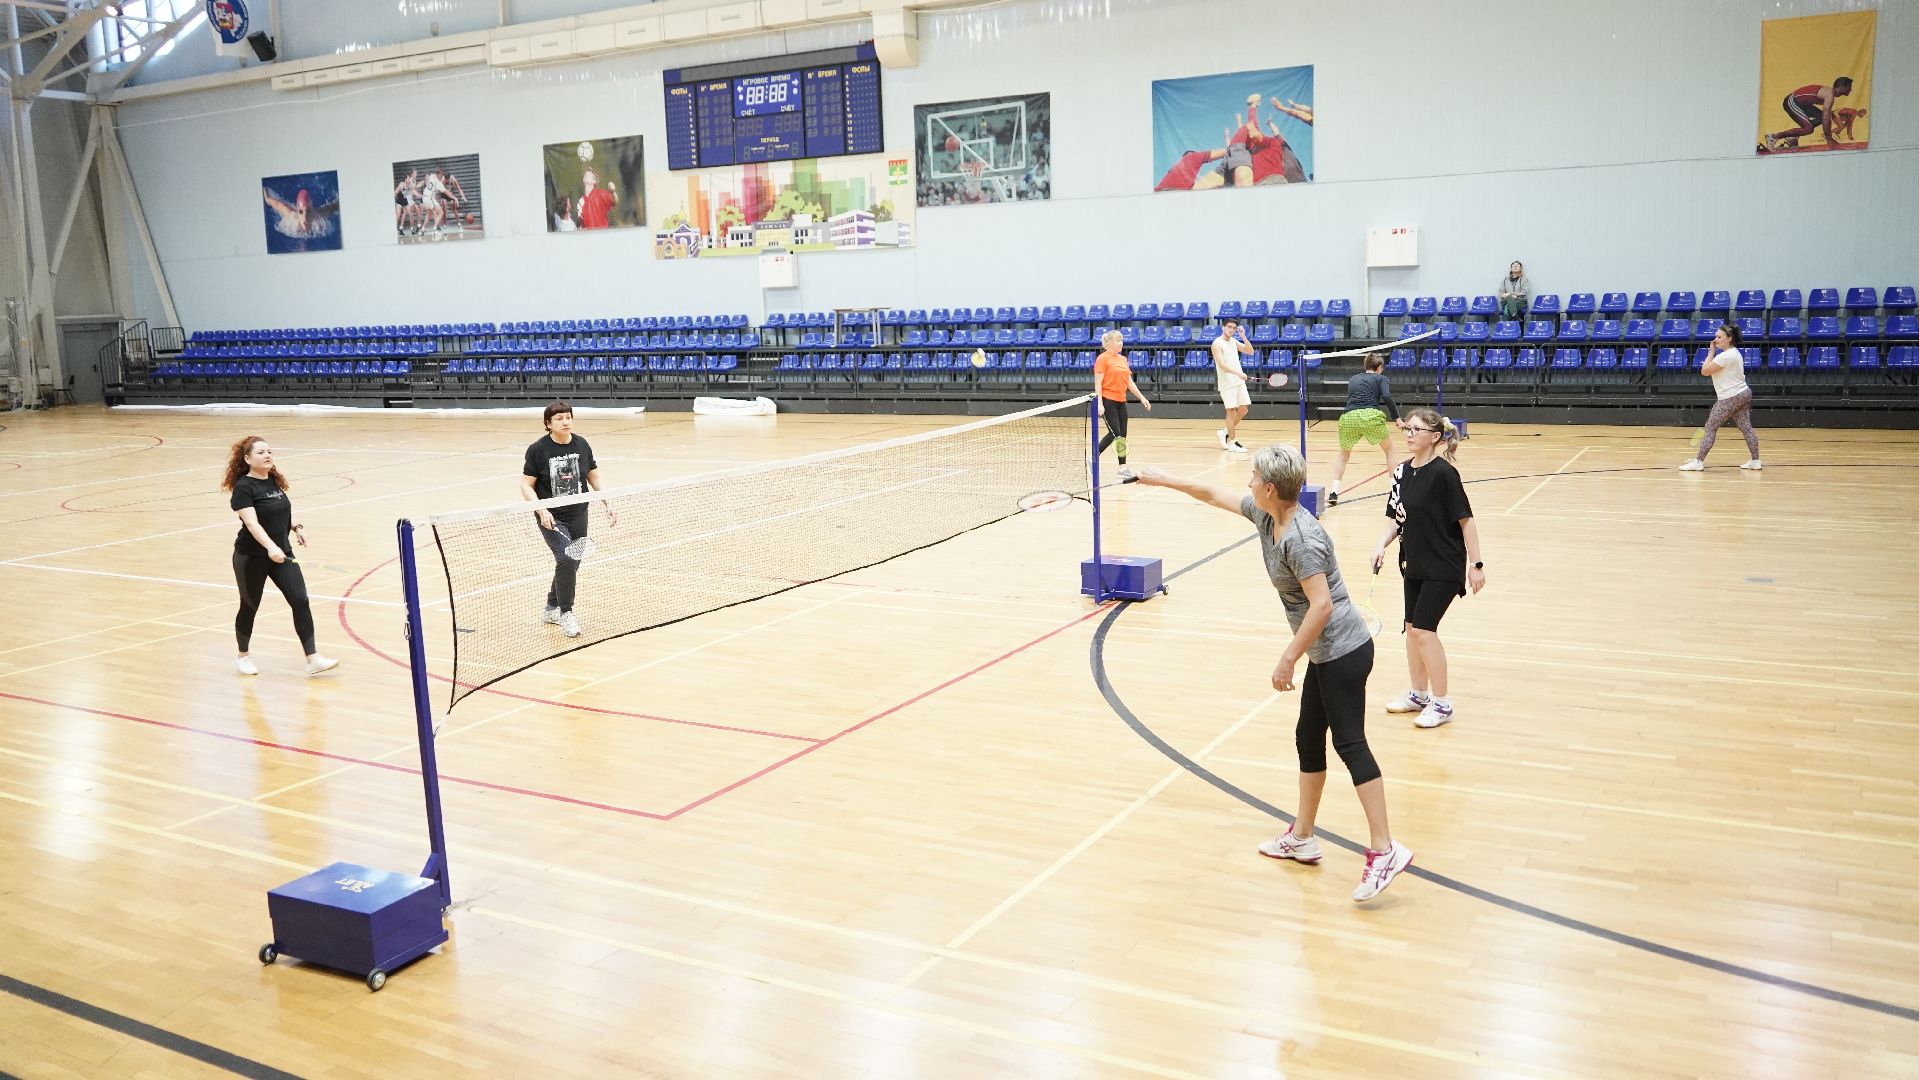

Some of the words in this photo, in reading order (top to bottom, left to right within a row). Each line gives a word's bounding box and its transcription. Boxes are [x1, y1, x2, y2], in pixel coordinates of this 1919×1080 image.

[817, 69, 837, 78] ВРЕМЯ
[742, 76, 768, 86] ИГРОВОЕ
[770, 74, 791, 83] ВРЕМЯ
[709, 82, 727, 91] ВРЕМЯ
[745, 83, 788, 105] 88:88
